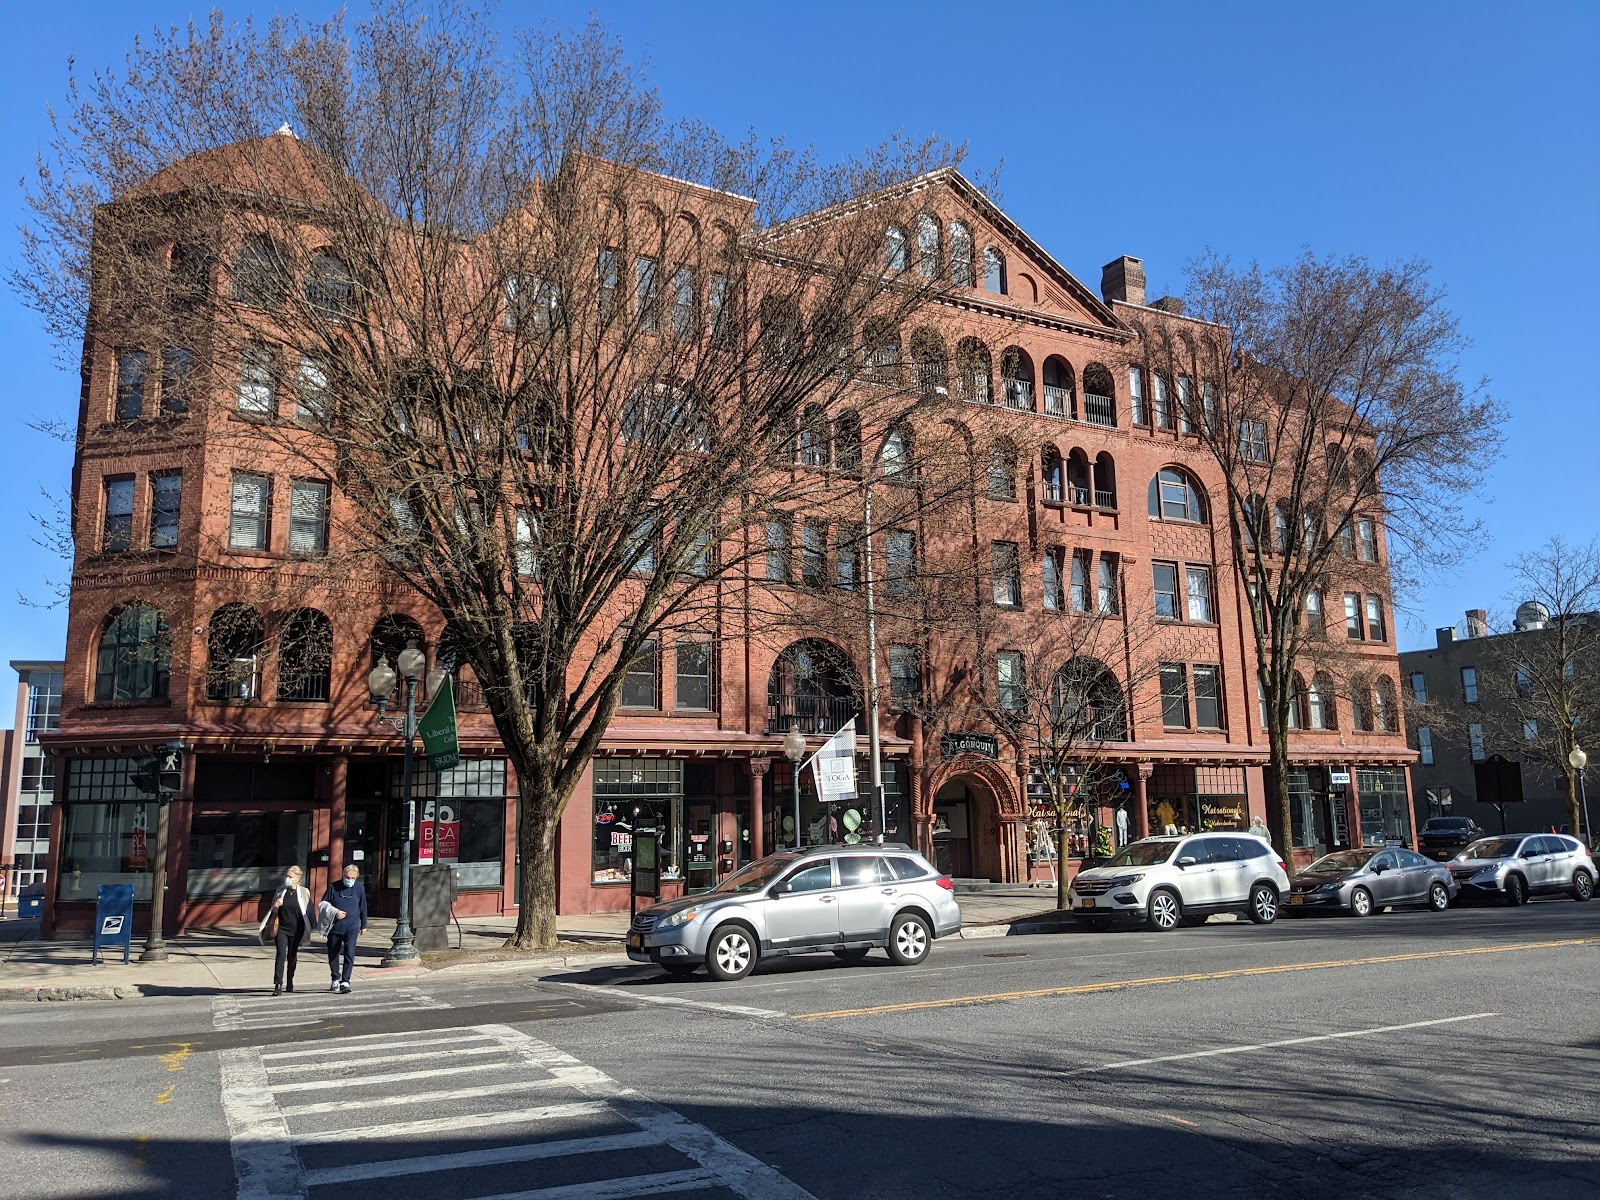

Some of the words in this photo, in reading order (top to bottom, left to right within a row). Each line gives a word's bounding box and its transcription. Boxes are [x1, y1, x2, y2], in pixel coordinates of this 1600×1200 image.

[427, 725, 450, 738] Liberal
[949, 739, 994, 754] ALGONQUIN
[434, 753, 457, 767] SKIDM
[825, 774, 850, 782] TOGA
[424, 827, 456, 841] BCA
